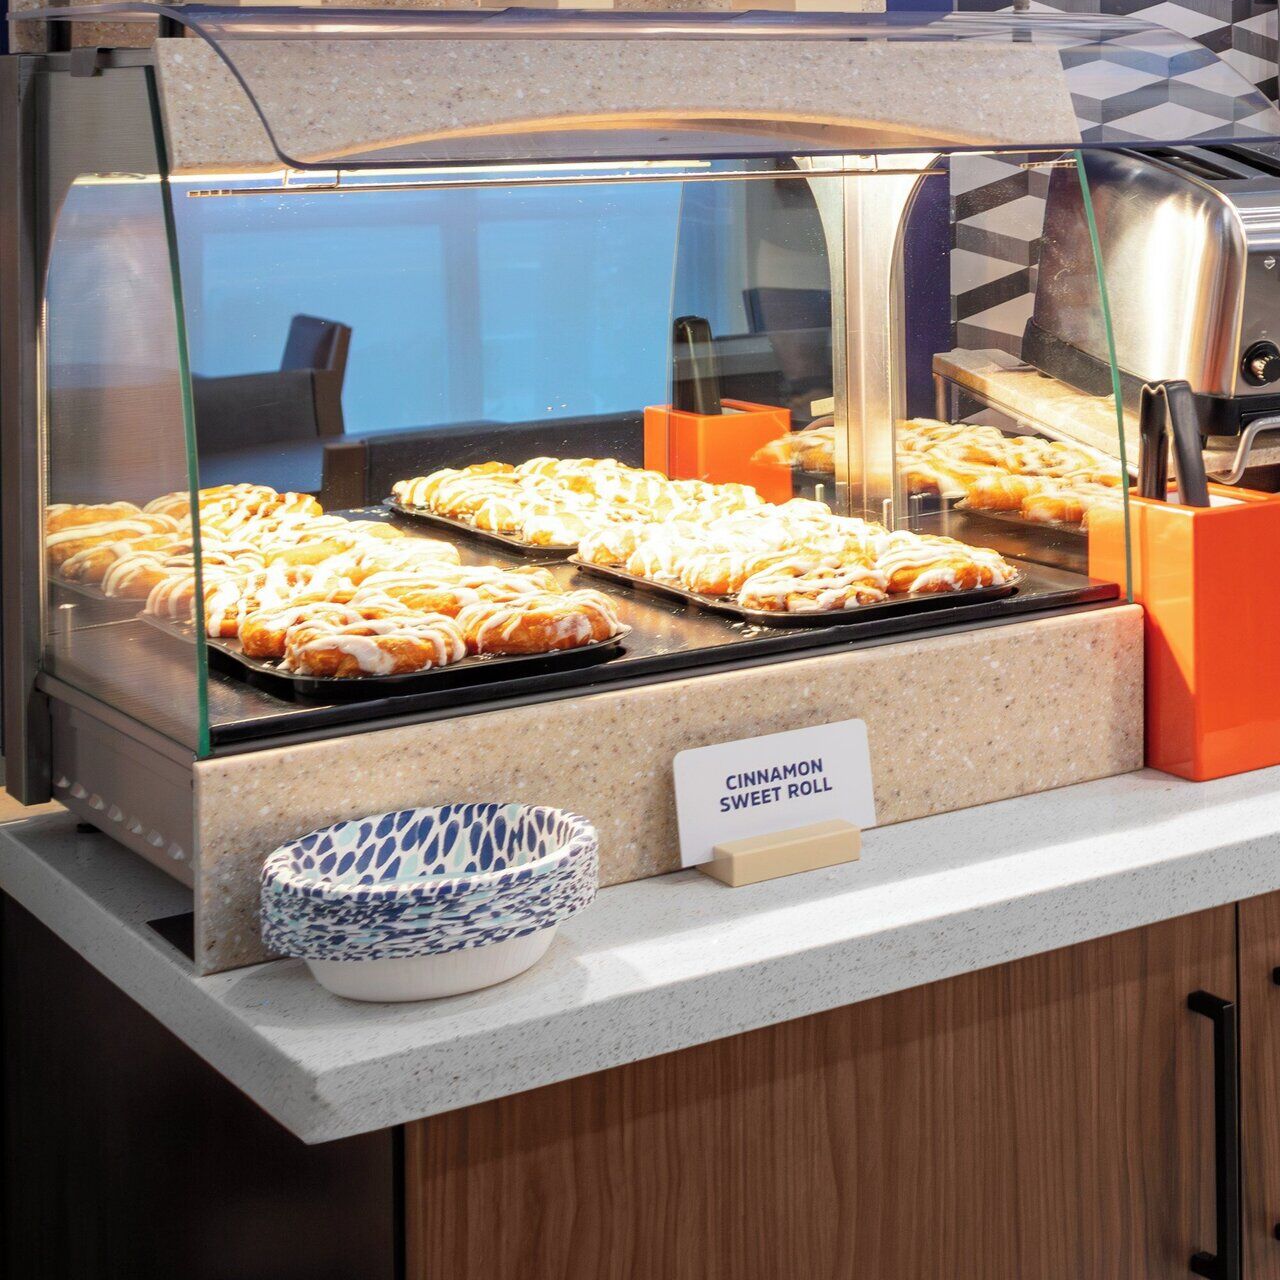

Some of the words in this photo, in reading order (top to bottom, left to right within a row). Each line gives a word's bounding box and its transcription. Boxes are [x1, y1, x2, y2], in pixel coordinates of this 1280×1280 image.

[726, 758, 823, 790] CINNAMON
[719, 786, 782, 813] SWEET
[788, 776, 832, 799] ROLL
